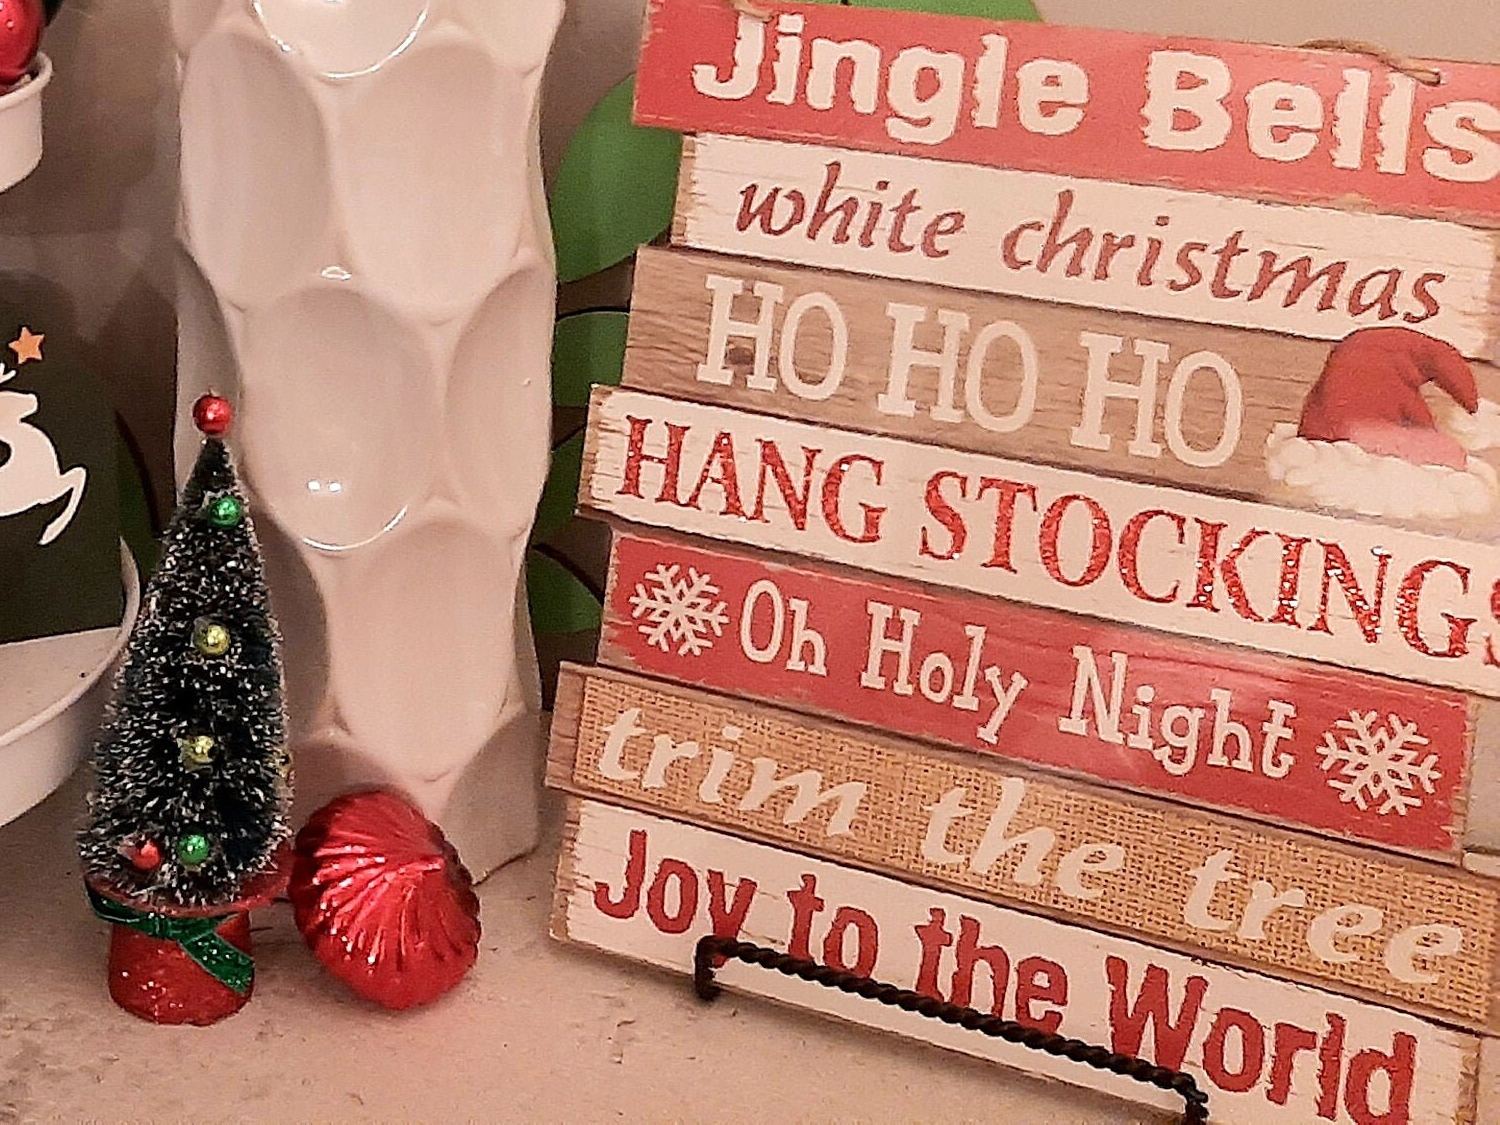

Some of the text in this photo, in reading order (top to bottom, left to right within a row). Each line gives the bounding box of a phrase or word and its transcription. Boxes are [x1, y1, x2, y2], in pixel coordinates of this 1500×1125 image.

[690, 11, 1500, 184] Jingle Bells
[736, 160, 1451, 326] white christmas
[695, 274, 1244, 469] HO HO HO
[614, 412, 887, 548] HANG
[739, 580, 1297, 780] Oh Holy Night
[597, 708, 1463, 986] trim the tree
[593, 829, 1419, 1125] Joy to the World
